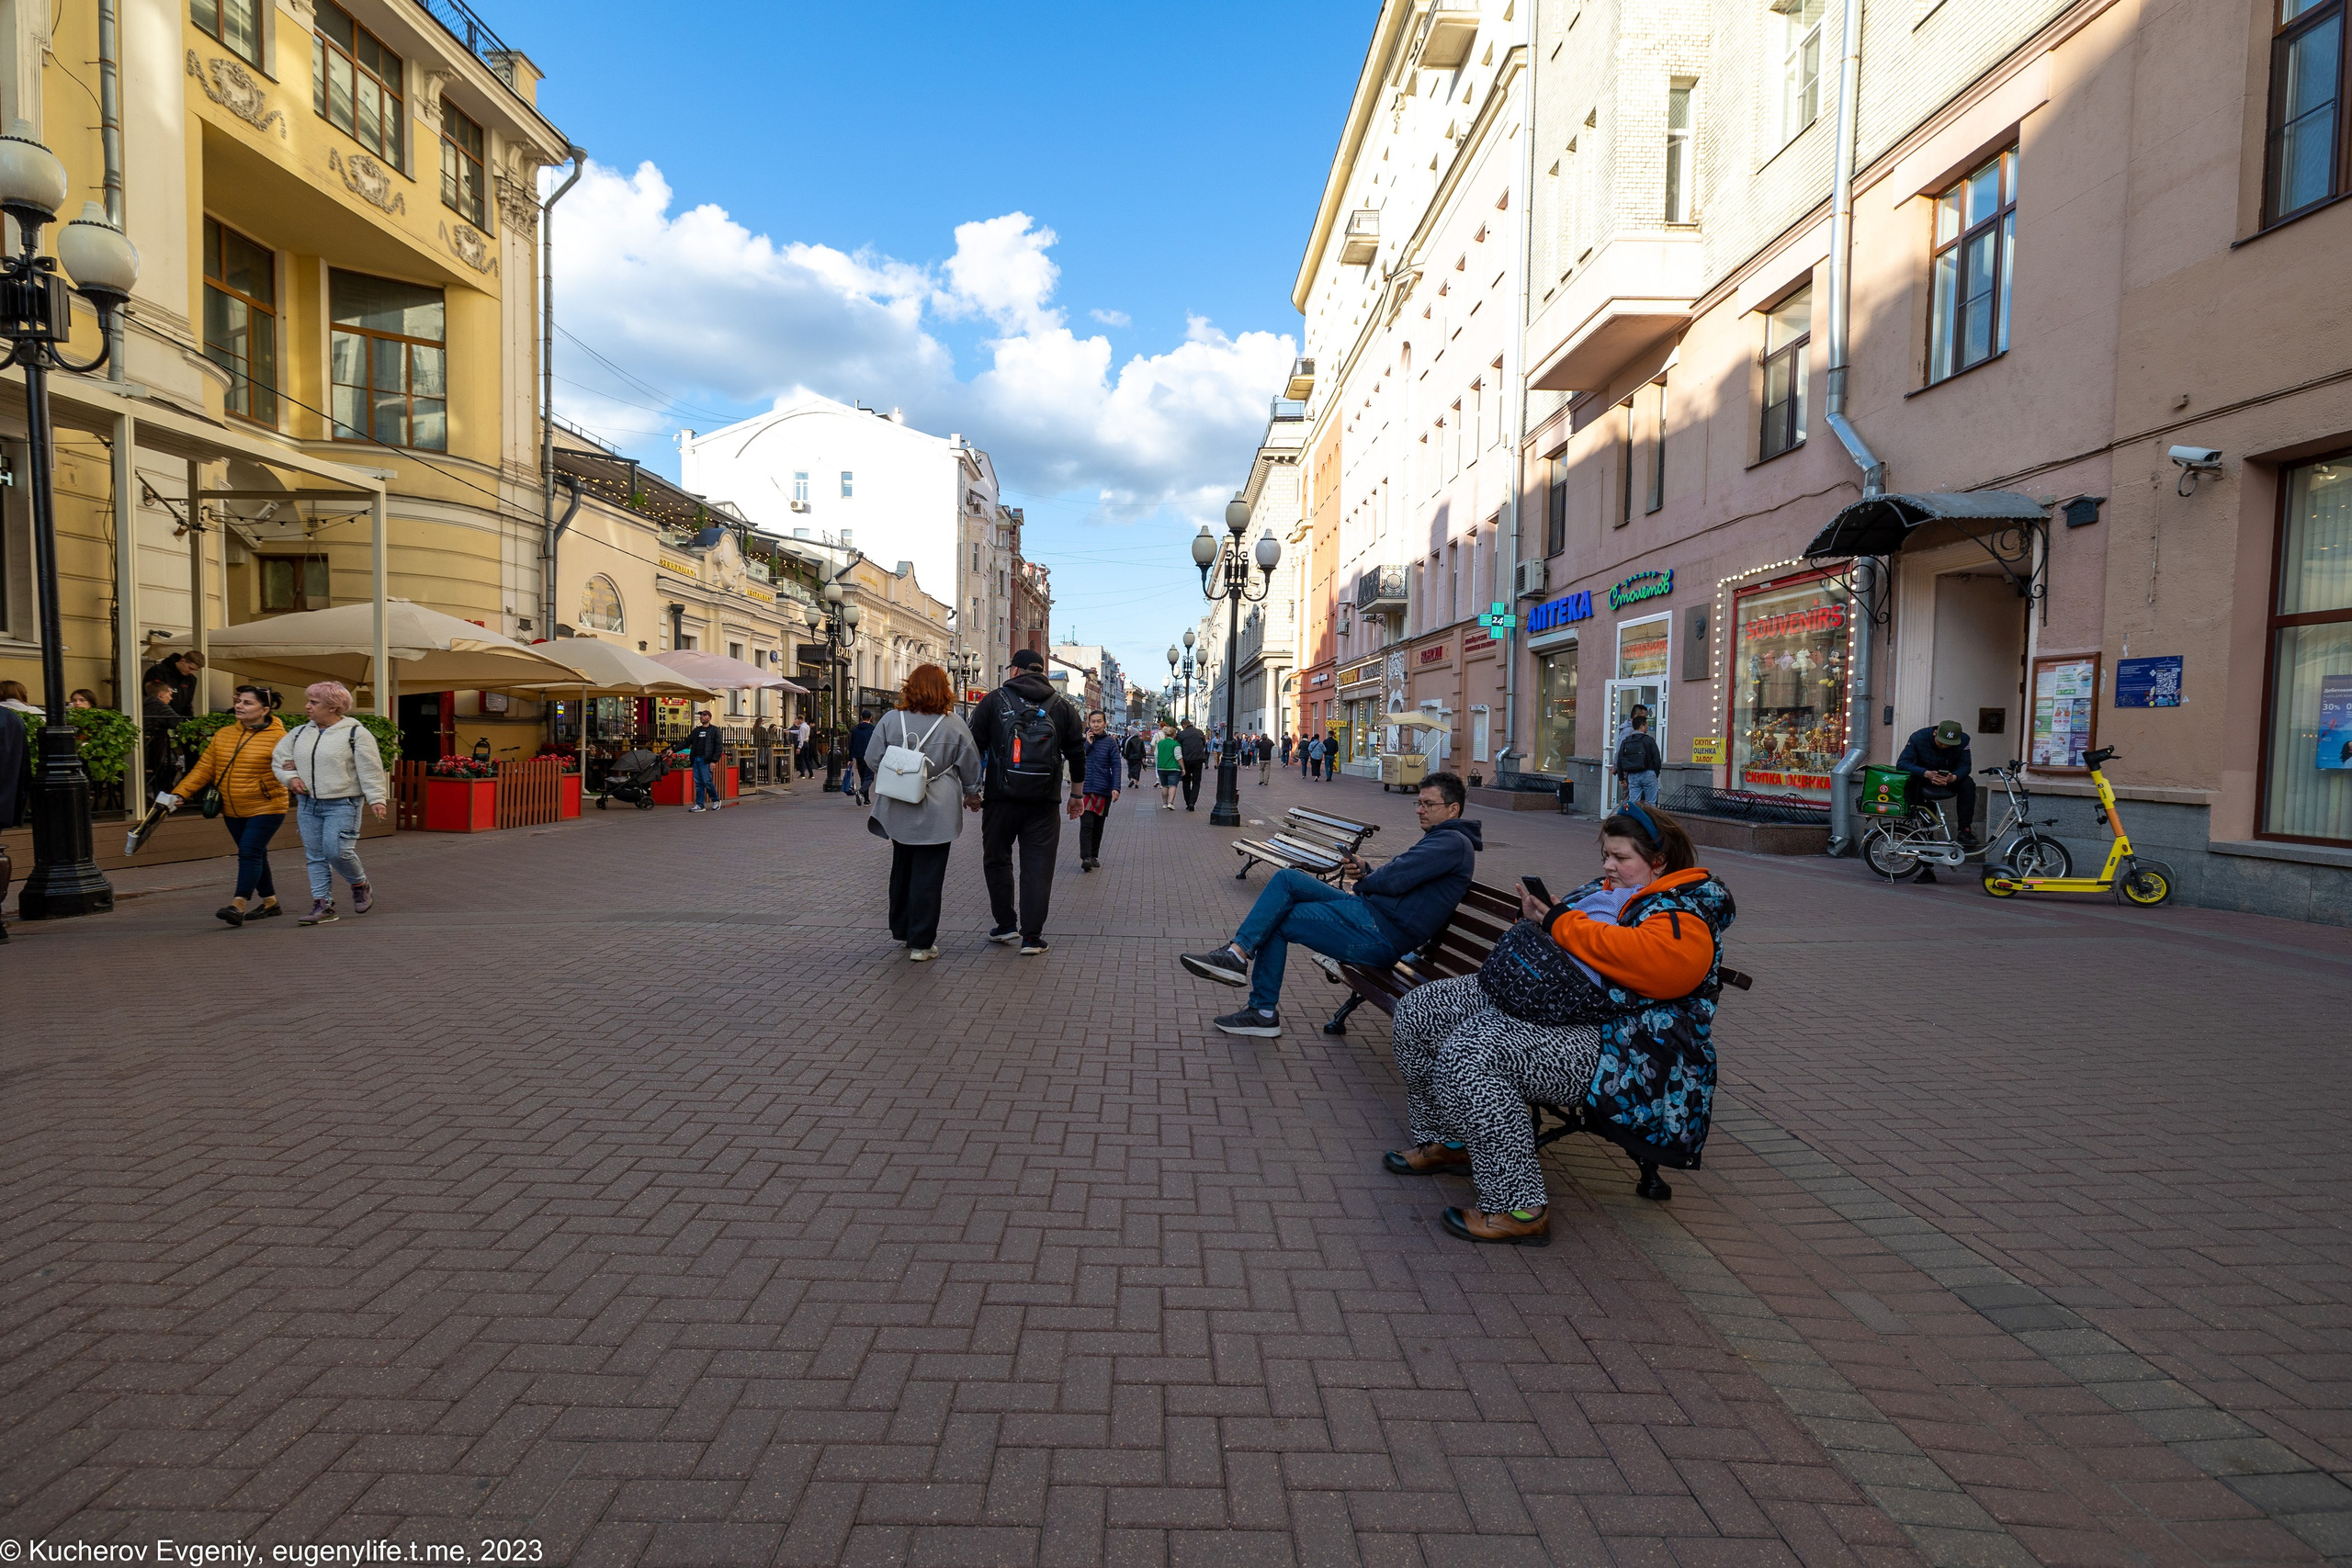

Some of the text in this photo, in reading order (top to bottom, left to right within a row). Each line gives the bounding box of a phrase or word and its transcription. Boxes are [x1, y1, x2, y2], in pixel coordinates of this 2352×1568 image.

[1609, 569, 1674, 610] Столетов
[1492, 616, 1504, 626] 24
[1527, 591, 1594, 633] АПТЕКА
[1746, 772, 1832, 790] СКУПКА ОЦЕНКА
